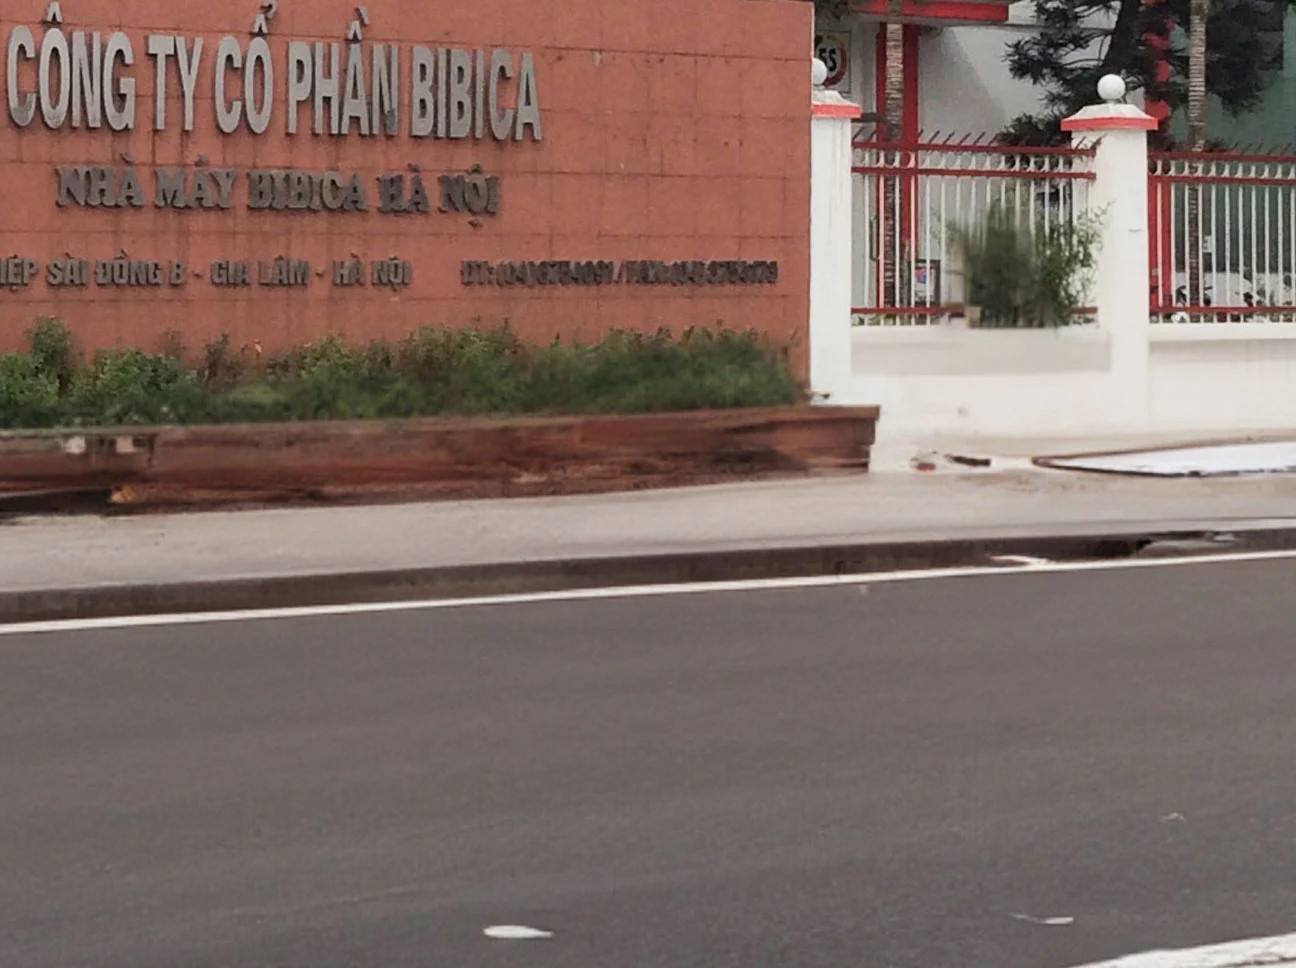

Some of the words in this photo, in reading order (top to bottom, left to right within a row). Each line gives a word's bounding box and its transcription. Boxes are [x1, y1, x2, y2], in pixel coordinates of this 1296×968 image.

[7, 1, 136, 130] CÔNG
[147, 34, 203, 130] TY
[287, 6, 398, 135] PHẦN
[411, 45, 541, 140] BIBICA
[55, 152, 144, 207] NHÀ
[247, 169, 369, 211] BIBICA
[376, 163, 429, 213] HÀ
[437, 163, 500, 228] NỘI
[170, 260, 186, 286] B
